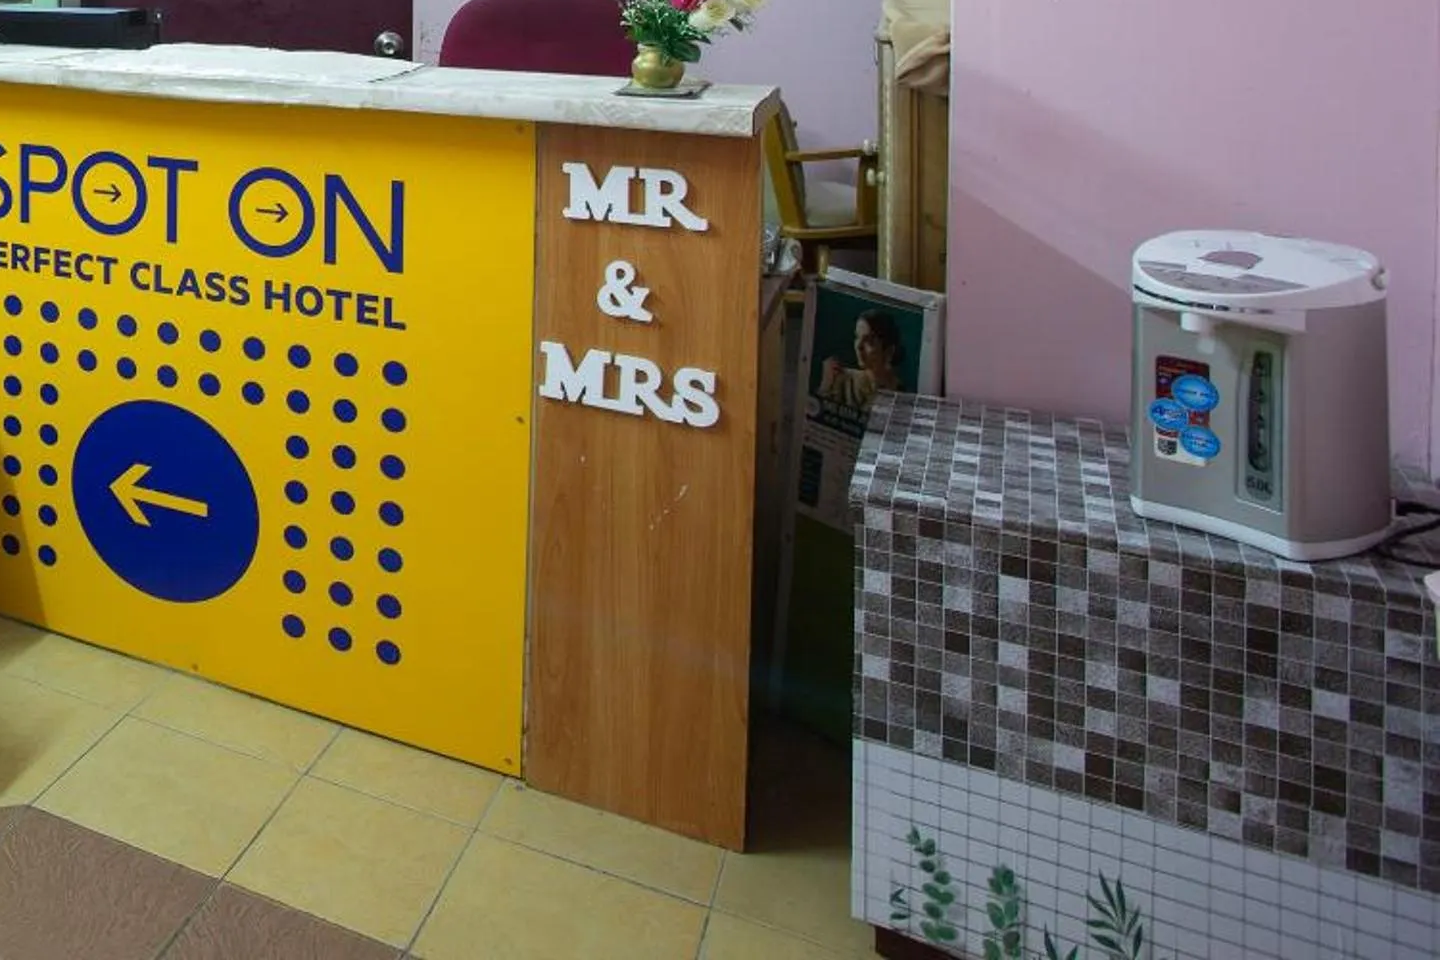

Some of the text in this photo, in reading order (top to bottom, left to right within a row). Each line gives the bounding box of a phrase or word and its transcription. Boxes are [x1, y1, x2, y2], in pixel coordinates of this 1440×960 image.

[228, 167, 404, 274] ON
[562, 162, 708, 231] MR
[130, 262, 250, 306] CLASS
[264, 280, 407, 330] HOTEL
[597, 260, 653, 322] &
[539, 341, 720, 427] MRS
